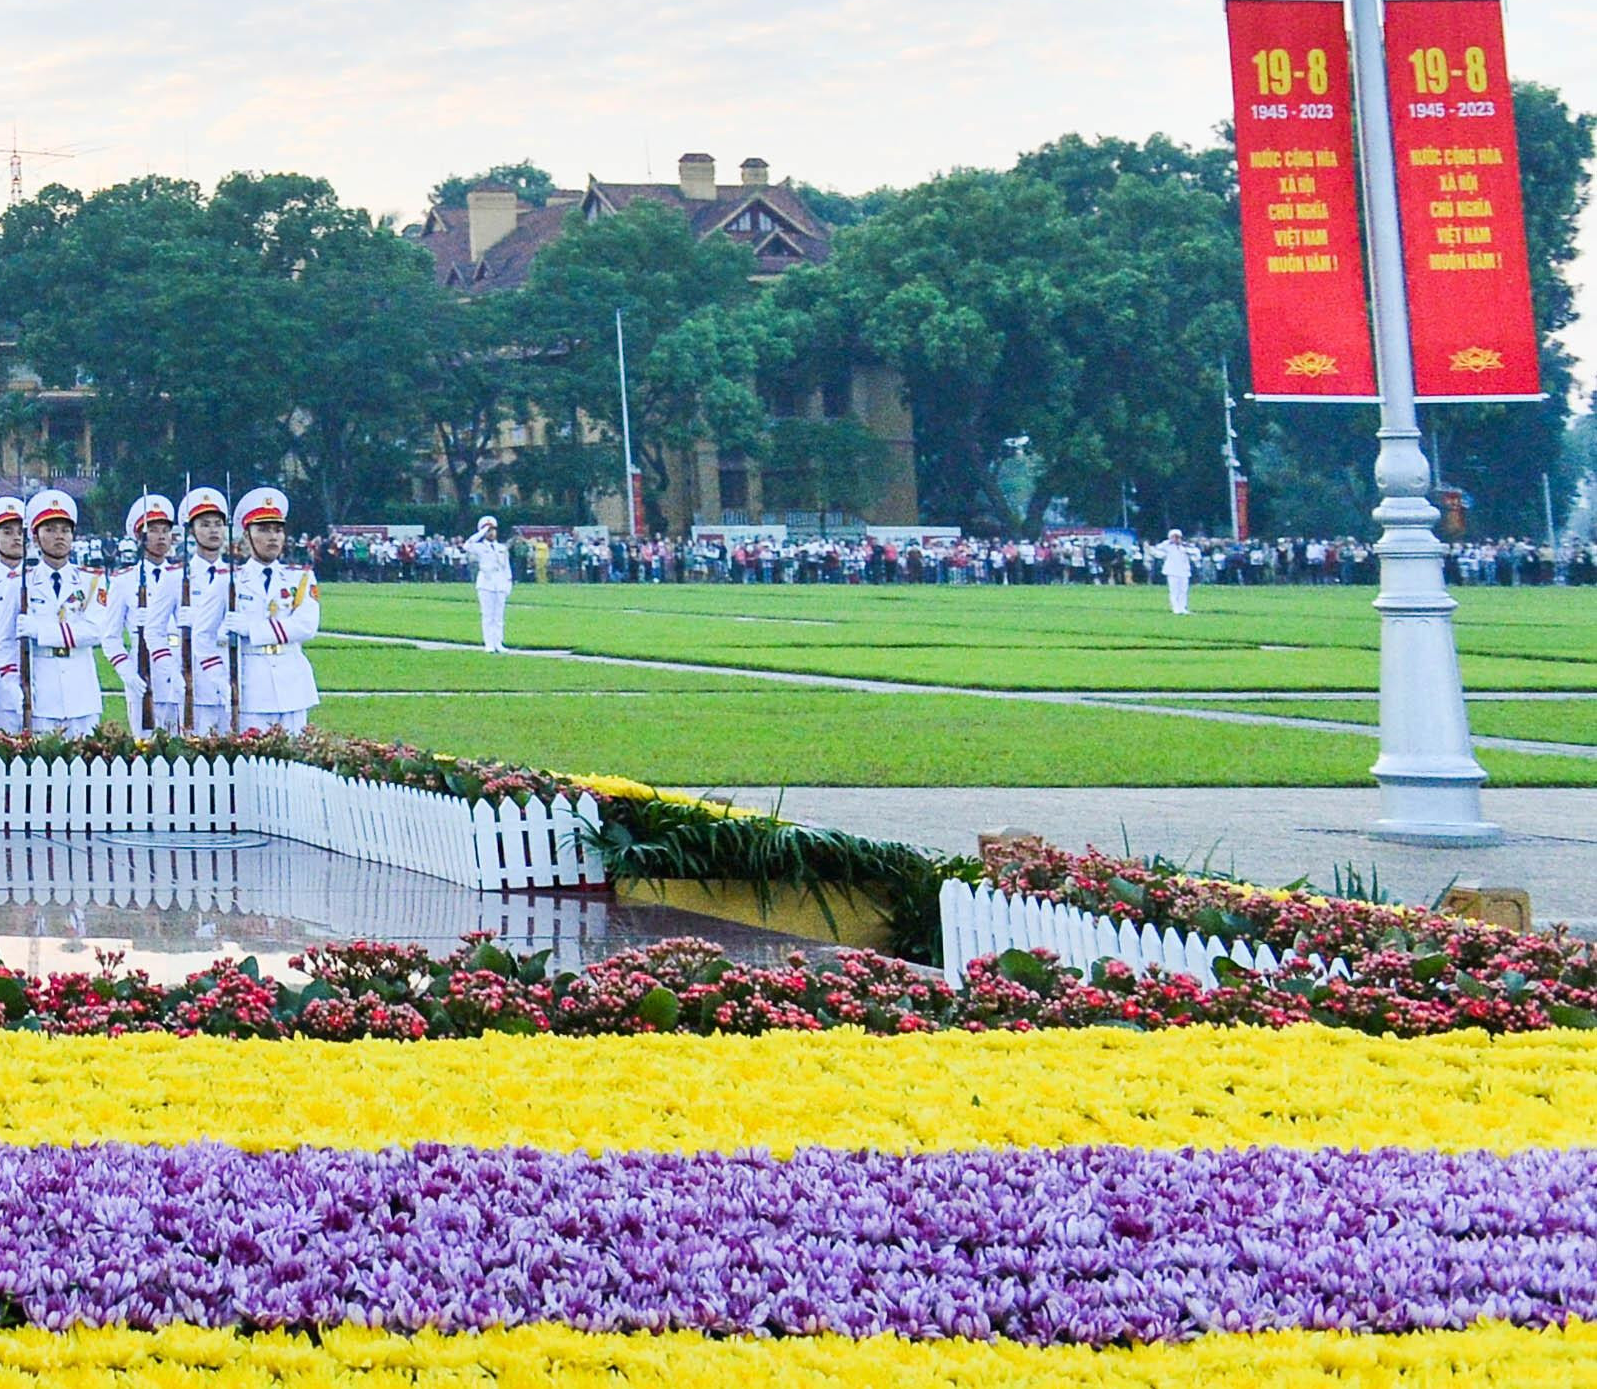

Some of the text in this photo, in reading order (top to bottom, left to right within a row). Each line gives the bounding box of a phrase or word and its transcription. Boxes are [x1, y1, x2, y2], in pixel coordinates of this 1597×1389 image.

[1252, 48, 1328, 95] 19-8
[1408, 47, 1488, 94] 19-8
[1251, 104, 1288, 119] 1945
[1299, 104, 1334, 119] 2023
[1408, 102, 1445, 118] 1945
[1457, 101, 1495, 117] 2023
